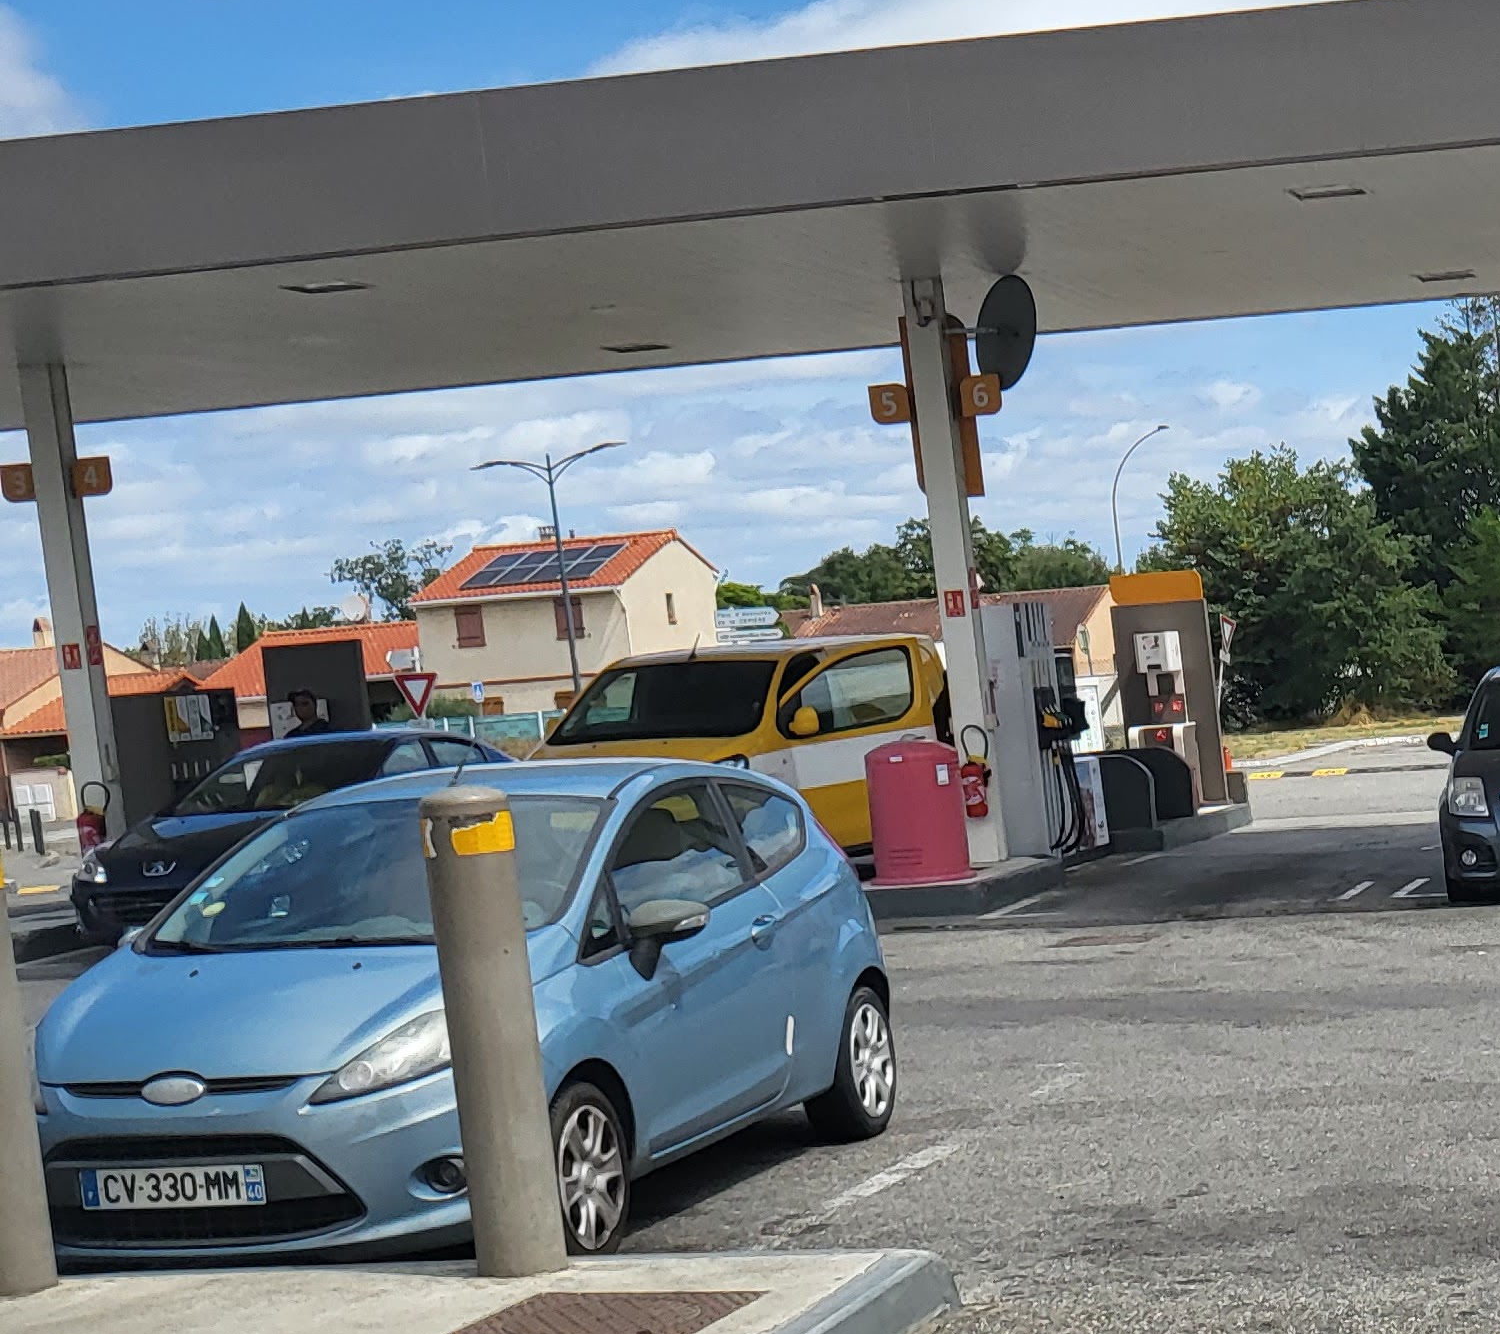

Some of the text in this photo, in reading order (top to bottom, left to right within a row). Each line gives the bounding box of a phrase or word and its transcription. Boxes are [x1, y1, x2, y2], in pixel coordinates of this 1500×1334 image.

[881, 391, 897, 417] 5
[972, 382, 989, 408] 6
[84, 466, 98, 488] 4
